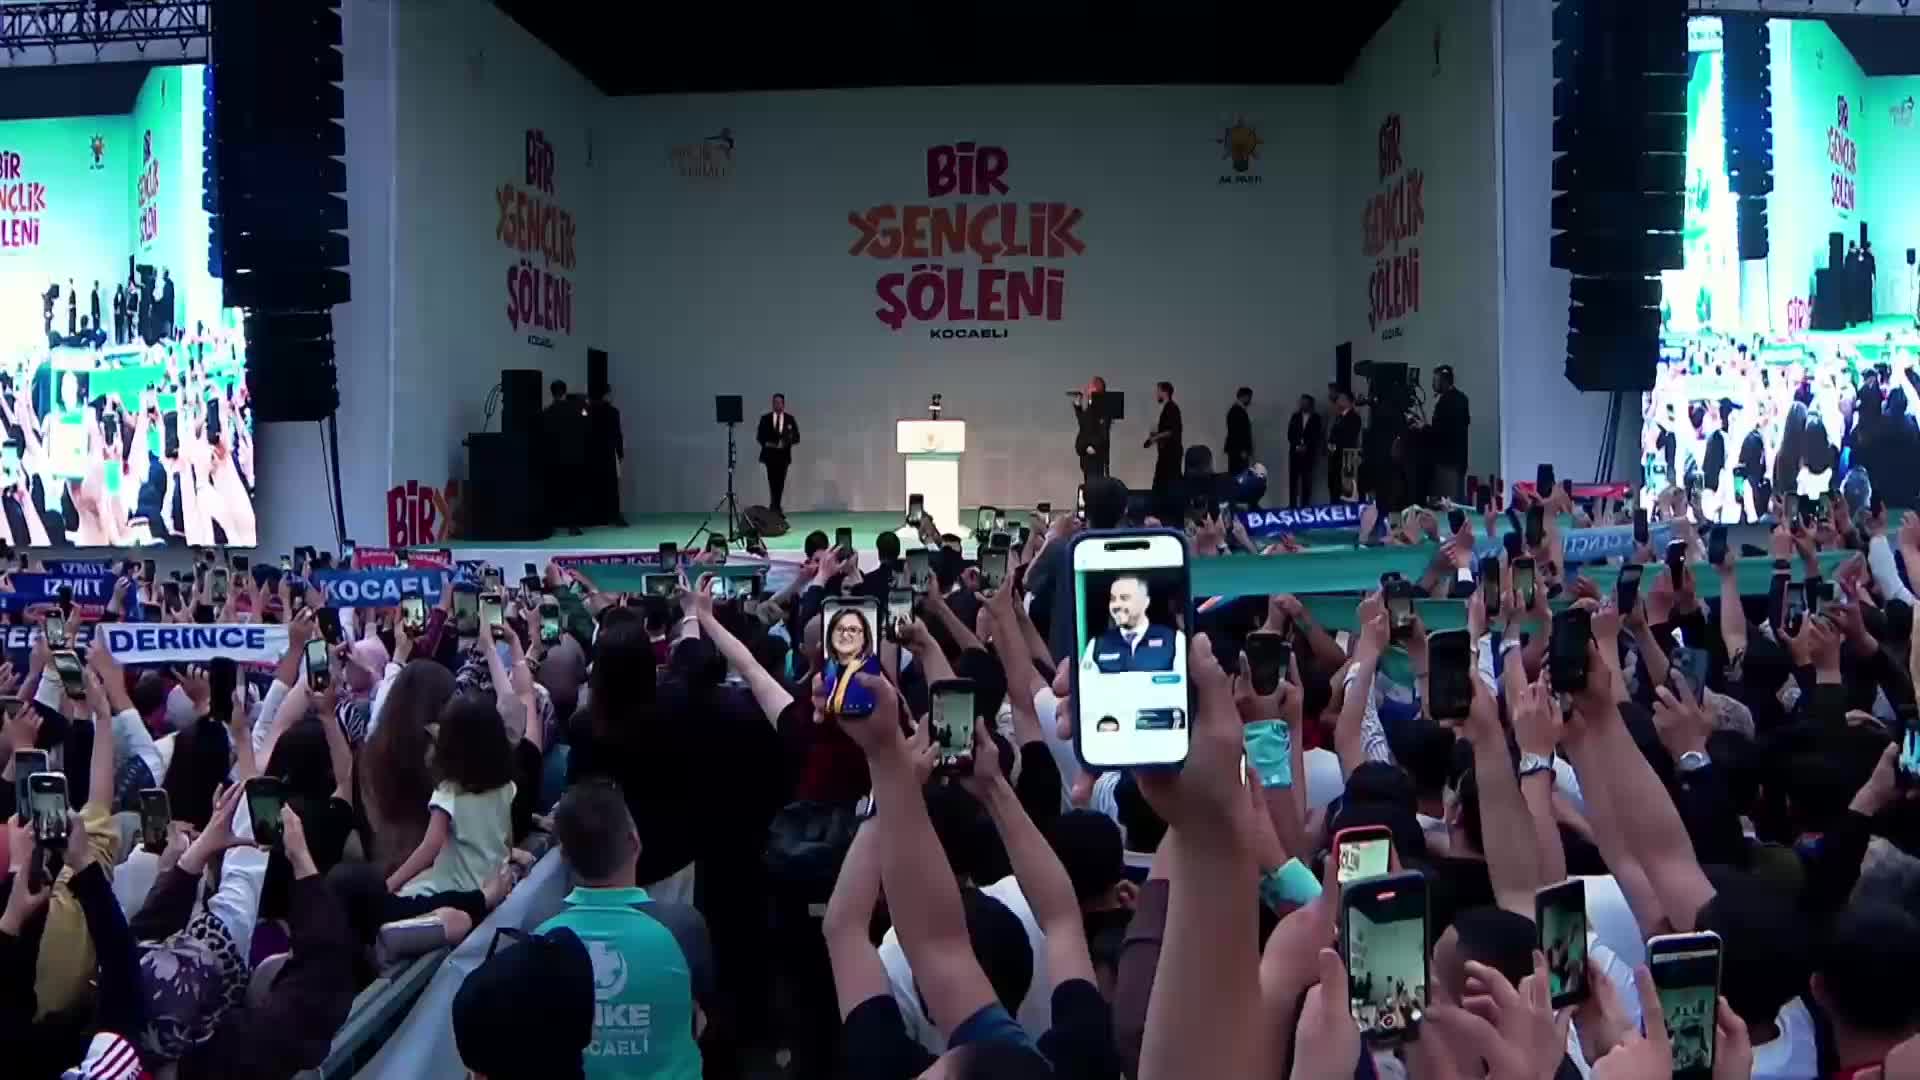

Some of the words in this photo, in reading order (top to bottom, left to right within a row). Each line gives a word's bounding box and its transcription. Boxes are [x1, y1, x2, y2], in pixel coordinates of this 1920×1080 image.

[526, 127, 555, 197] BİR
[927, 142, 1009, 197] BİR
[848, 202, 1086, 264] GENÇLİK
[507, 258, 572, 336] ŞÖLENİ
[875, 263, 1064, 331] ŞÖLENİ
[387, 480, 435, 547] BİR
